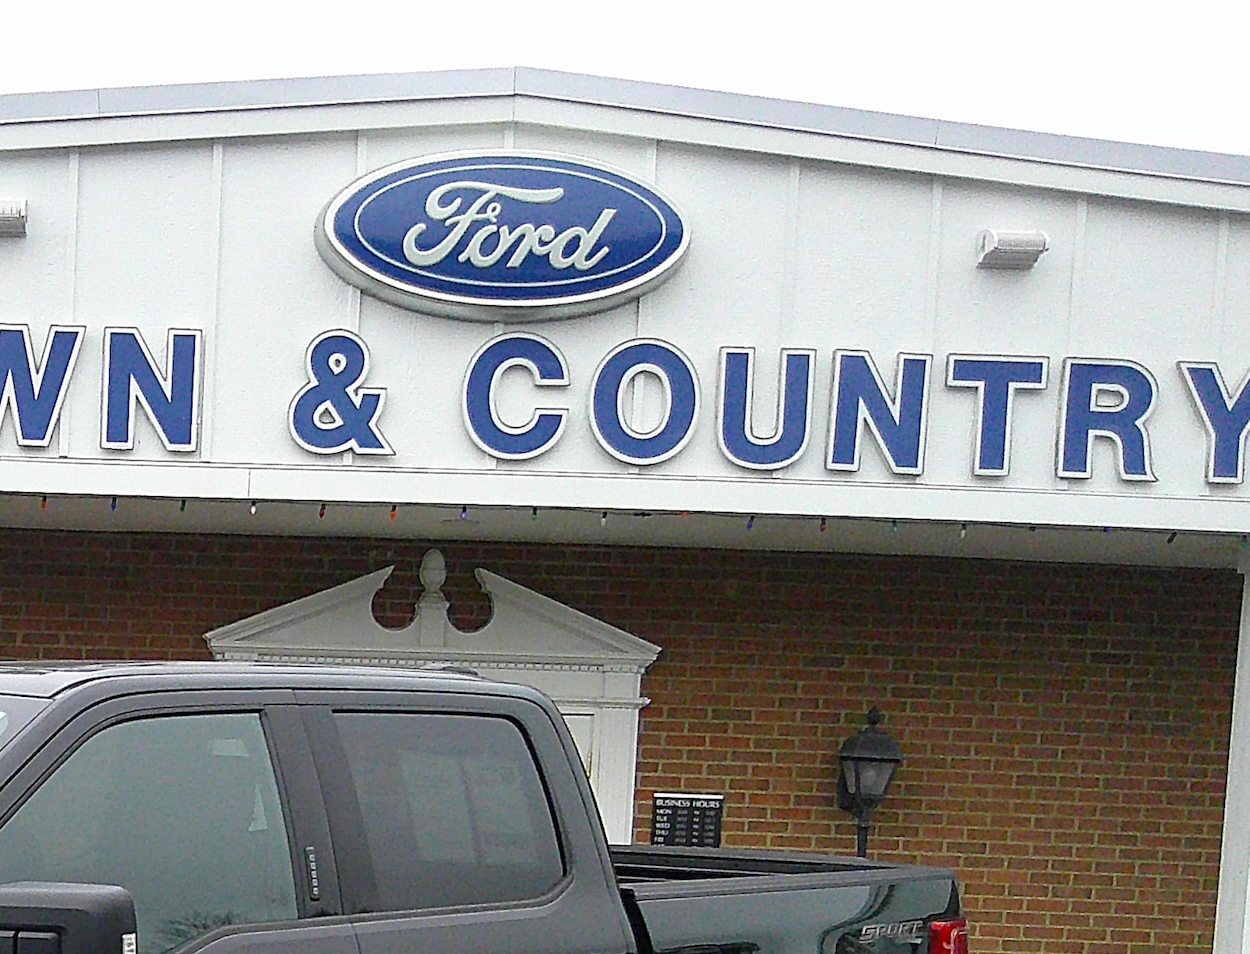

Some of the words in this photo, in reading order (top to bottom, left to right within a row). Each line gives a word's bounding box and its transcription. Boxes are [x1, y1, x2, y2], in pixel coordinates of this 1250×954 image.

[403, 181, 618, 271] Ford
[288, 329, 396, 456] &
[462, 332, 1250, 484] COUNTRY
[656, 799, 690, 807] BUSINESS
